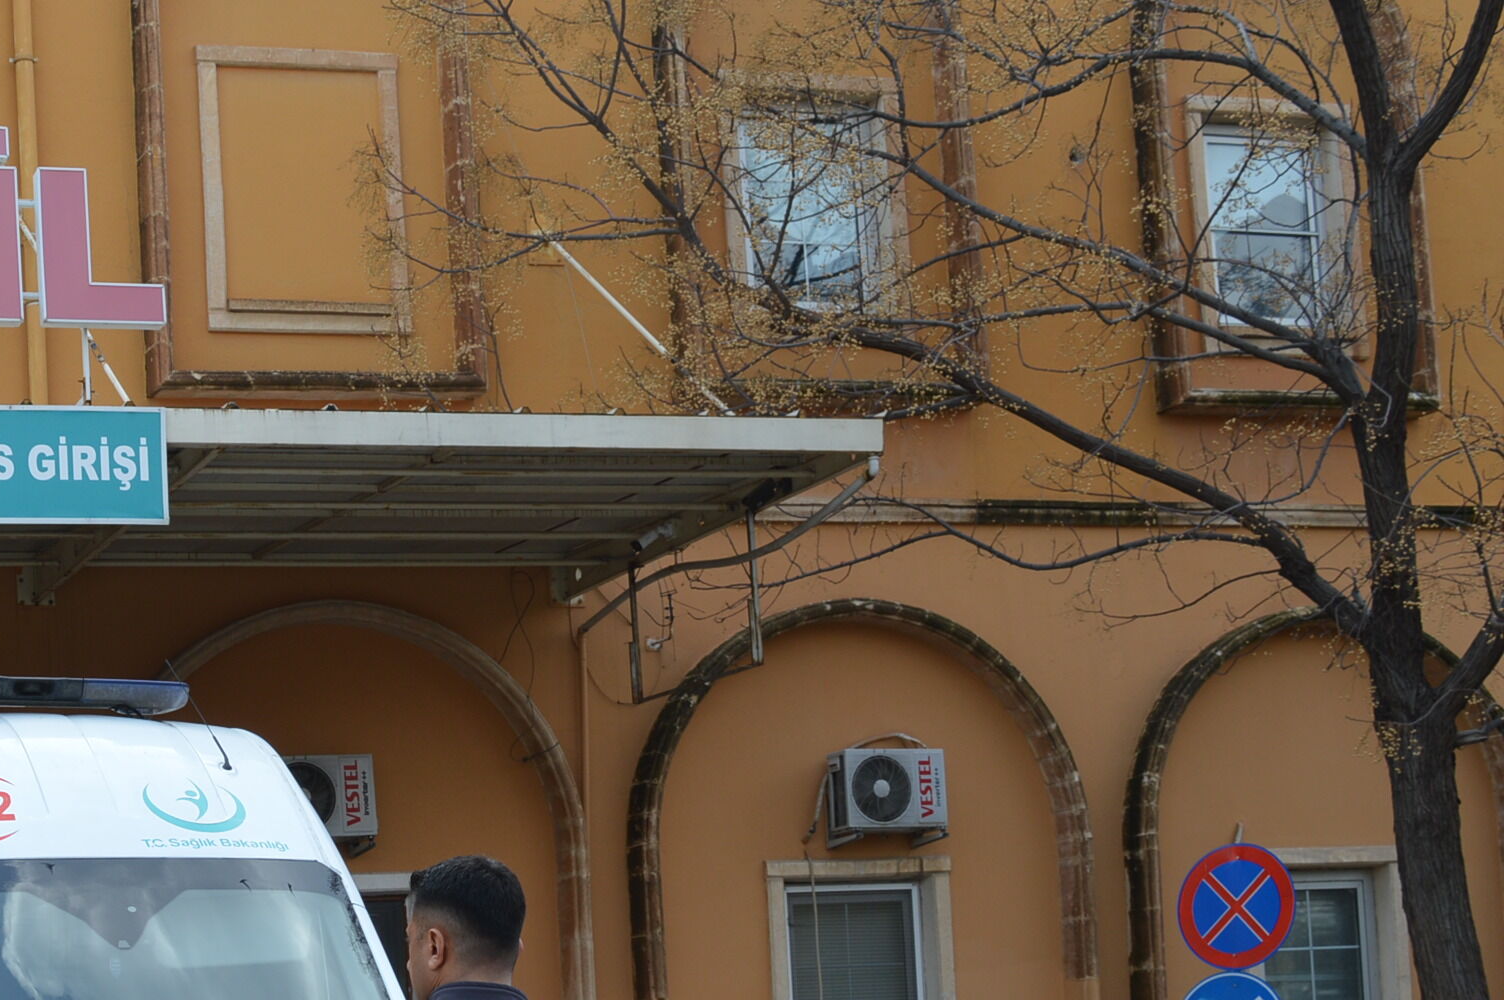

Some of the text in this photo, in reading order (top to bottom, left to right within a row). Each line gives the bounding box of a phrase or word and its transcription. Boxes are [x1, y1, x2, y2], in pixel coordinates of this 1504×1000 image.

[27, 435, 150, 491] GİRİŞİ
[343, 760, 362, 827] VESTEL
[918, 755, 935, 819] VESTEL
[168, 837, 217, 850] Sağlık
[219, 837, 290, 853] Bakanlığı
